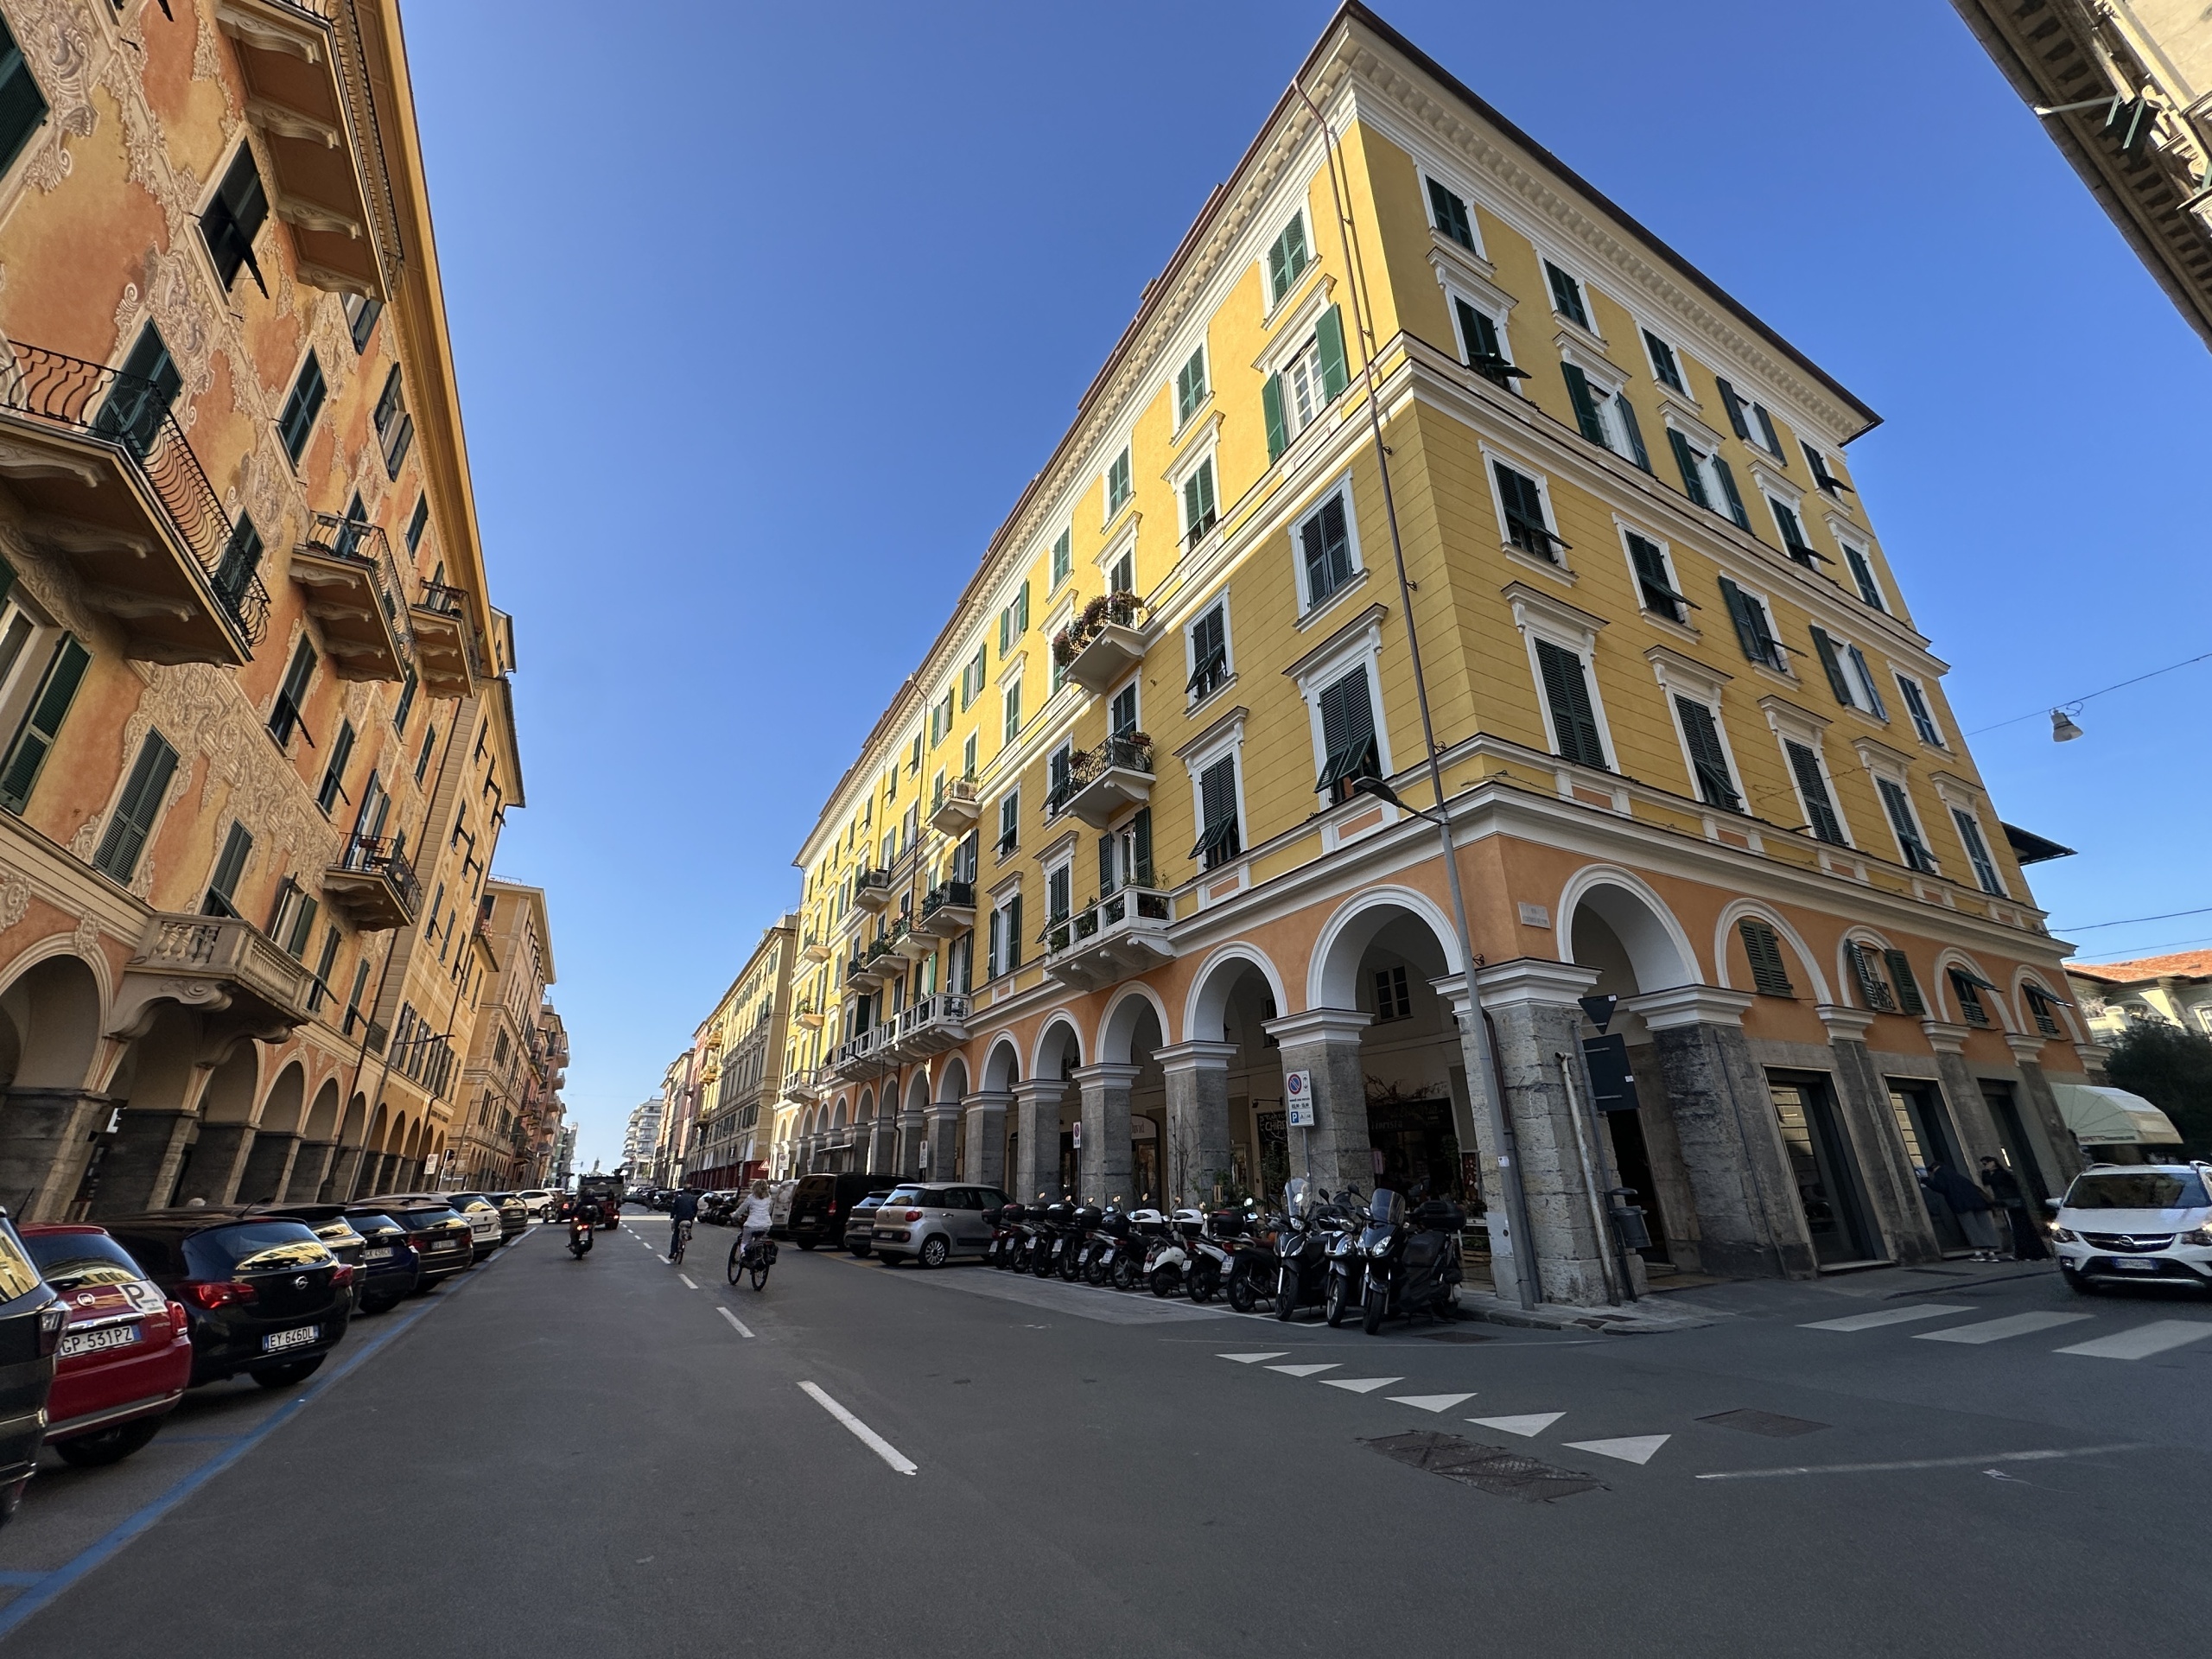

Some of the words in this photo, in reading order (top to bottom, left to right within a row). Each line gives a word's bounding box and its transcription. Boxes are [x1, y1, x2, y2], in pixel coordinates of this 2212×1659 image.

[1292, 1112, 1298, 1122] P
[120, 1283, 145, 1309] P
[87, 1326, 133, 1348] 531PZ
